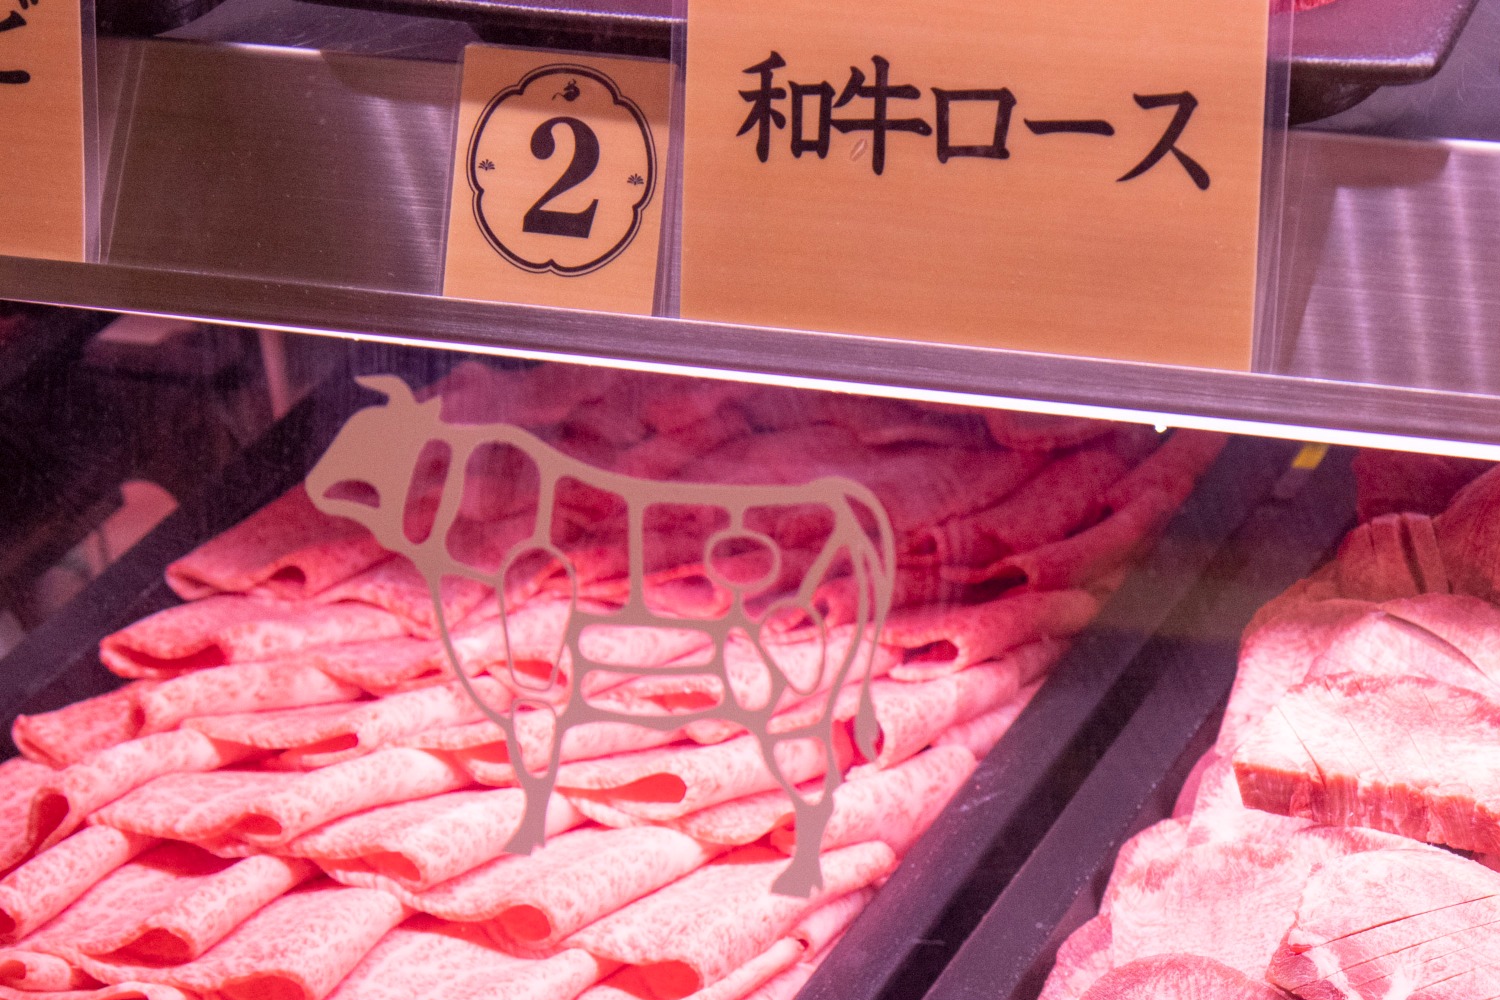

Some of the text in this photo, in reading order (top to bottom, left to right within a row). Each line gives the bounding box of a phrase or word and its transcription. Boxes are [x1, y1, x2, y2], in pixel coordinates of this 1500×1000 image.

[522, 116, 600, 238] 2
[736, 51, 1210, 190] 和牛ロース
